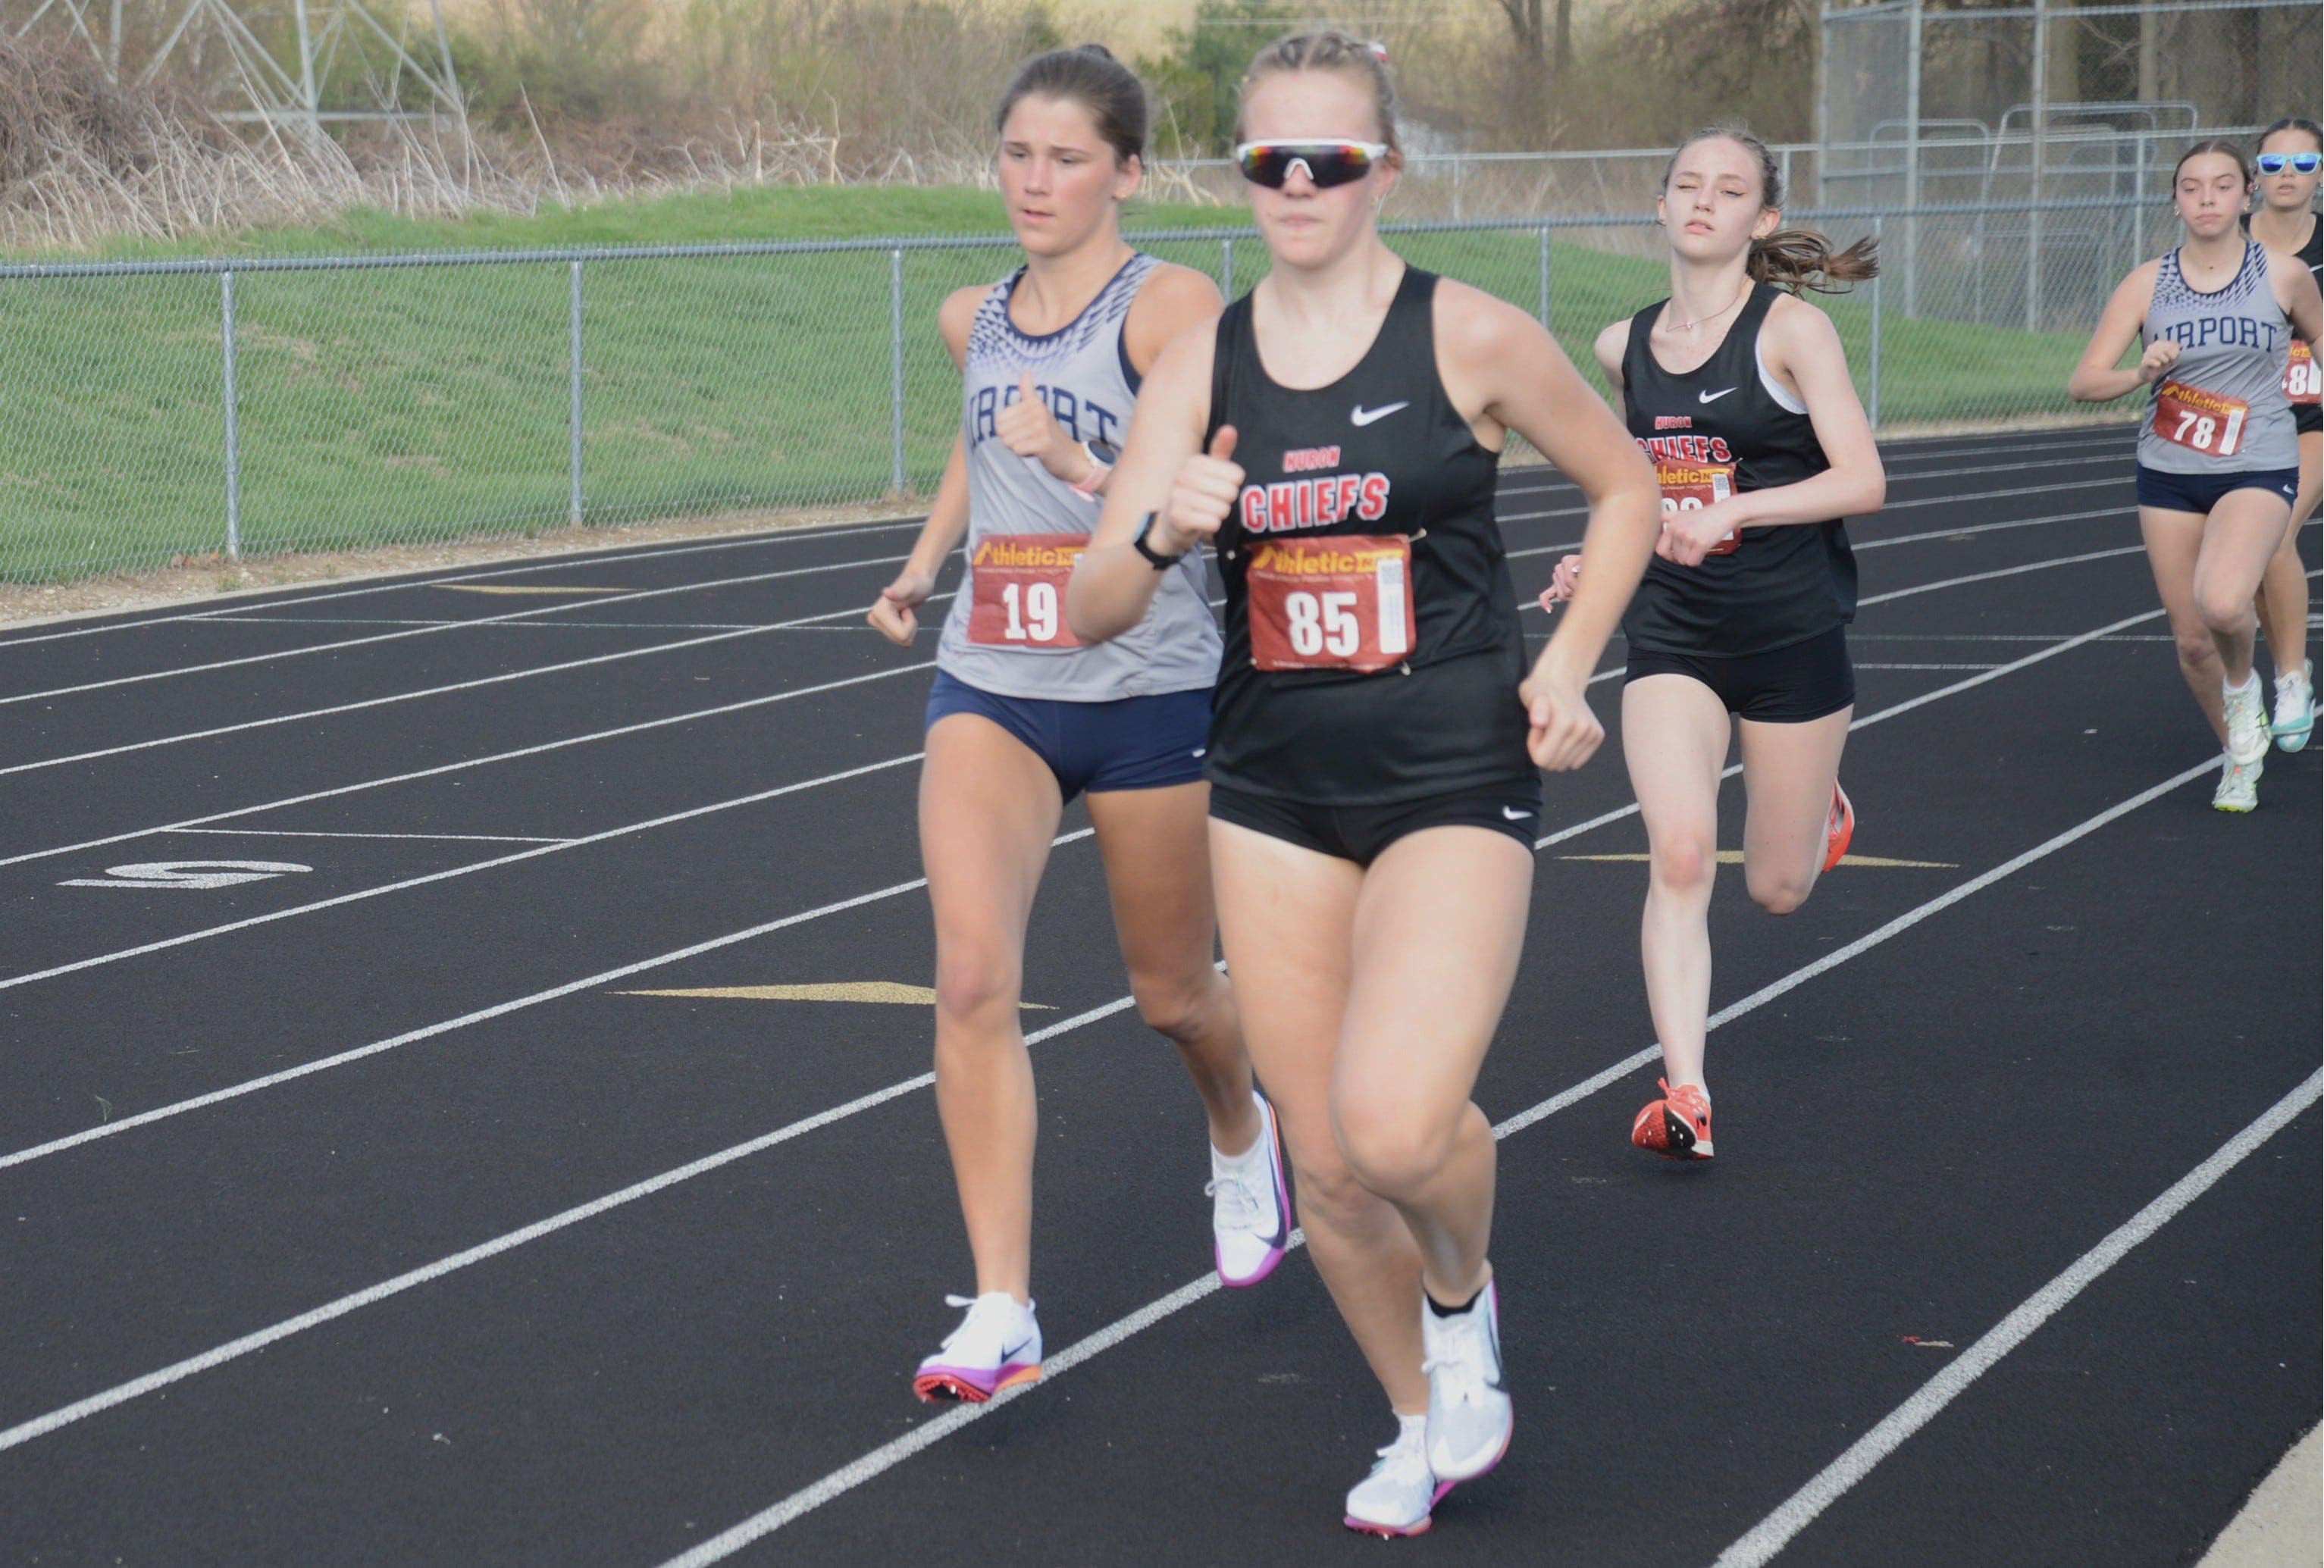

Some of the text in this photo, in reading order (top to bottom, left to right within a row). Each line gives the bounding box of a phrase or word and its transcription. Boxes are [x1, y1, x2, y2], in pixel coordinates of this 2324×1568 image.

[2154, 317, 2277, 352] IRPORT
[2282, 365, 2307, 396] 8
[1655, 416, 1693, 430] HURON
[2174, 410, 2216, 449] 78
[1283, 446, 1341, 472] HURON
[1240, 471, 1390, 534] CHIEFS
[1002, 582, 1058, 641] 19
[1286, 591, 1360, 657] 85
